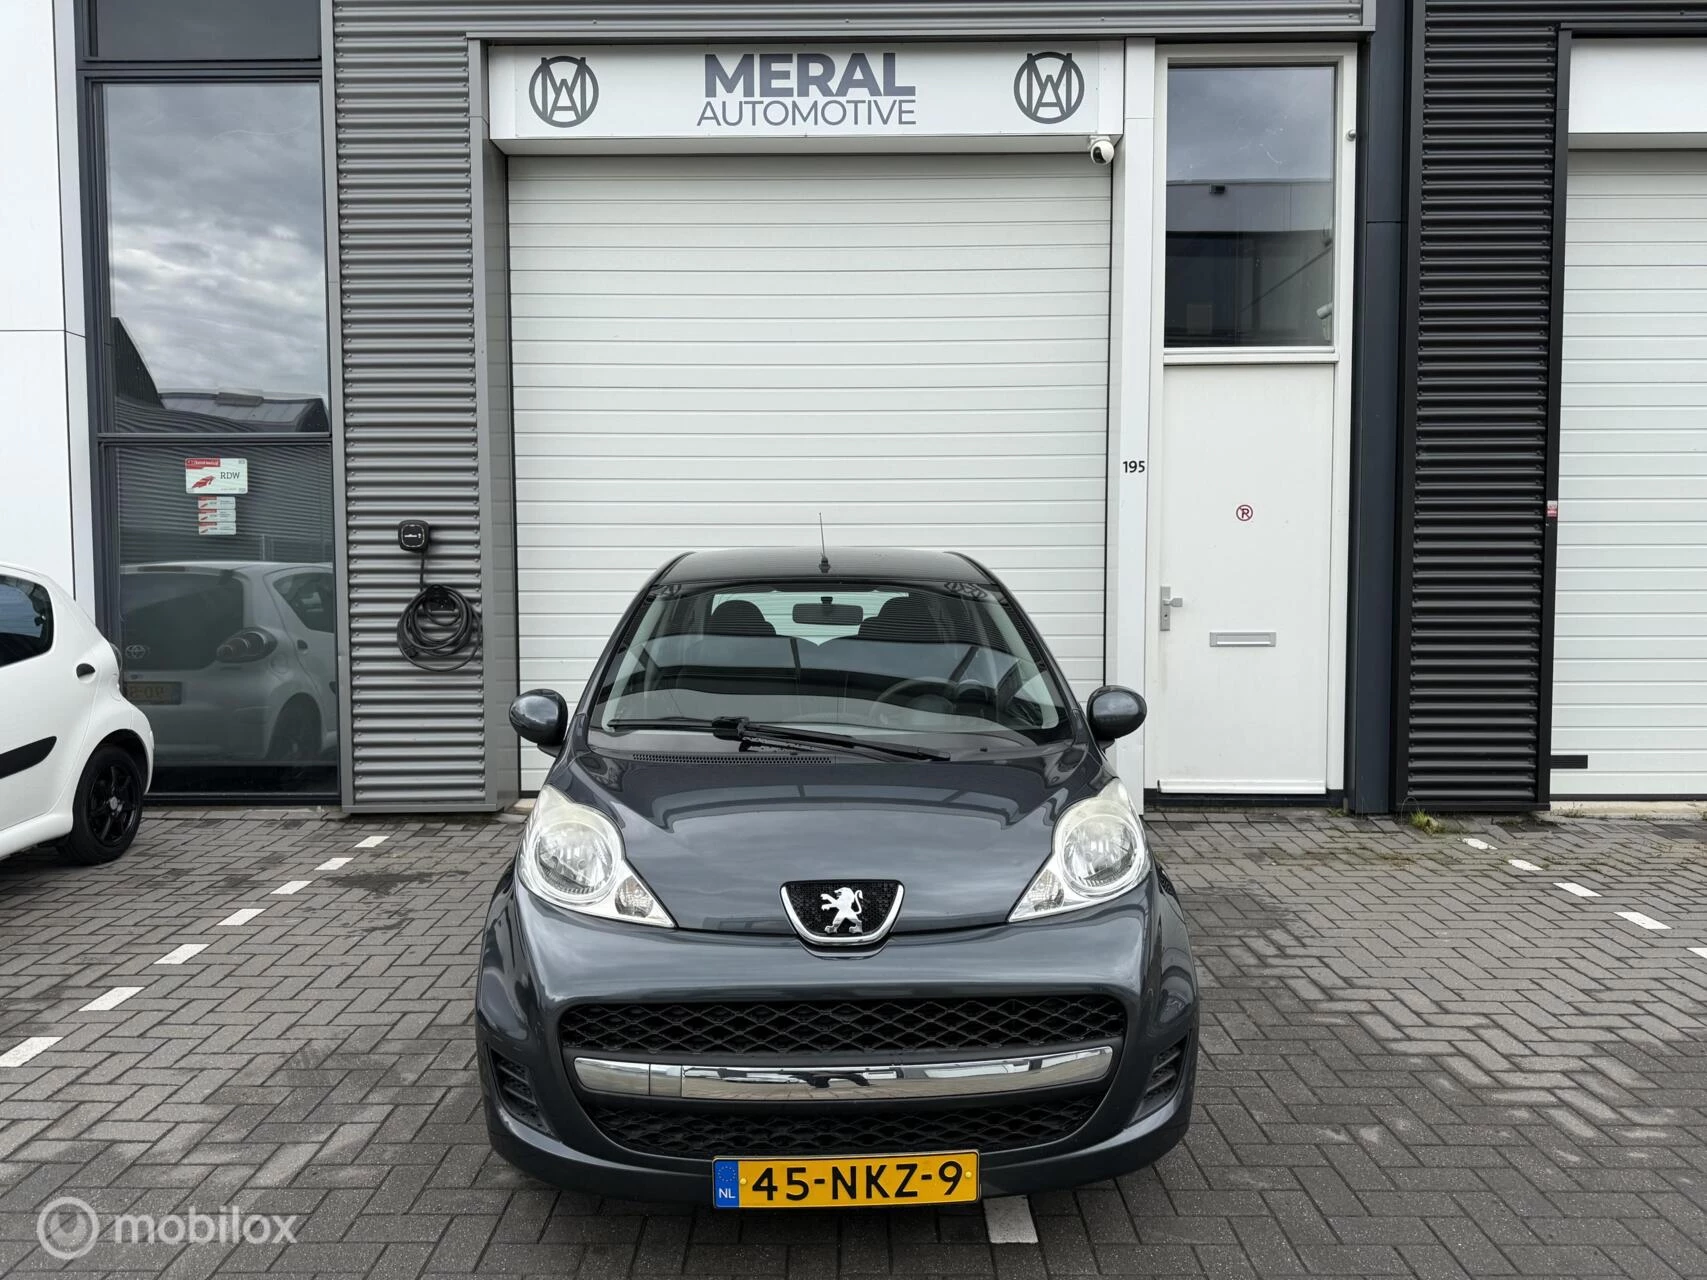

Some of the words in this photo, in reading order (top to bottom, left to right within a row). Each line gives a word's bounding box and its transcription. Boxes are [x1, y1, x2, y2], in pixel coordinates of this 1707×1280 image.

[705, 53, 916, 97] MERAL
[697, 100, 916, 126] AUTOMOTIVE
[220, 471, 240, 480] RDW
[1122, 460, 1145, 473] 195
[752, 1160, 963, 1201] 45-NKZ-9
[719, 1188, 736, 1199] NL
